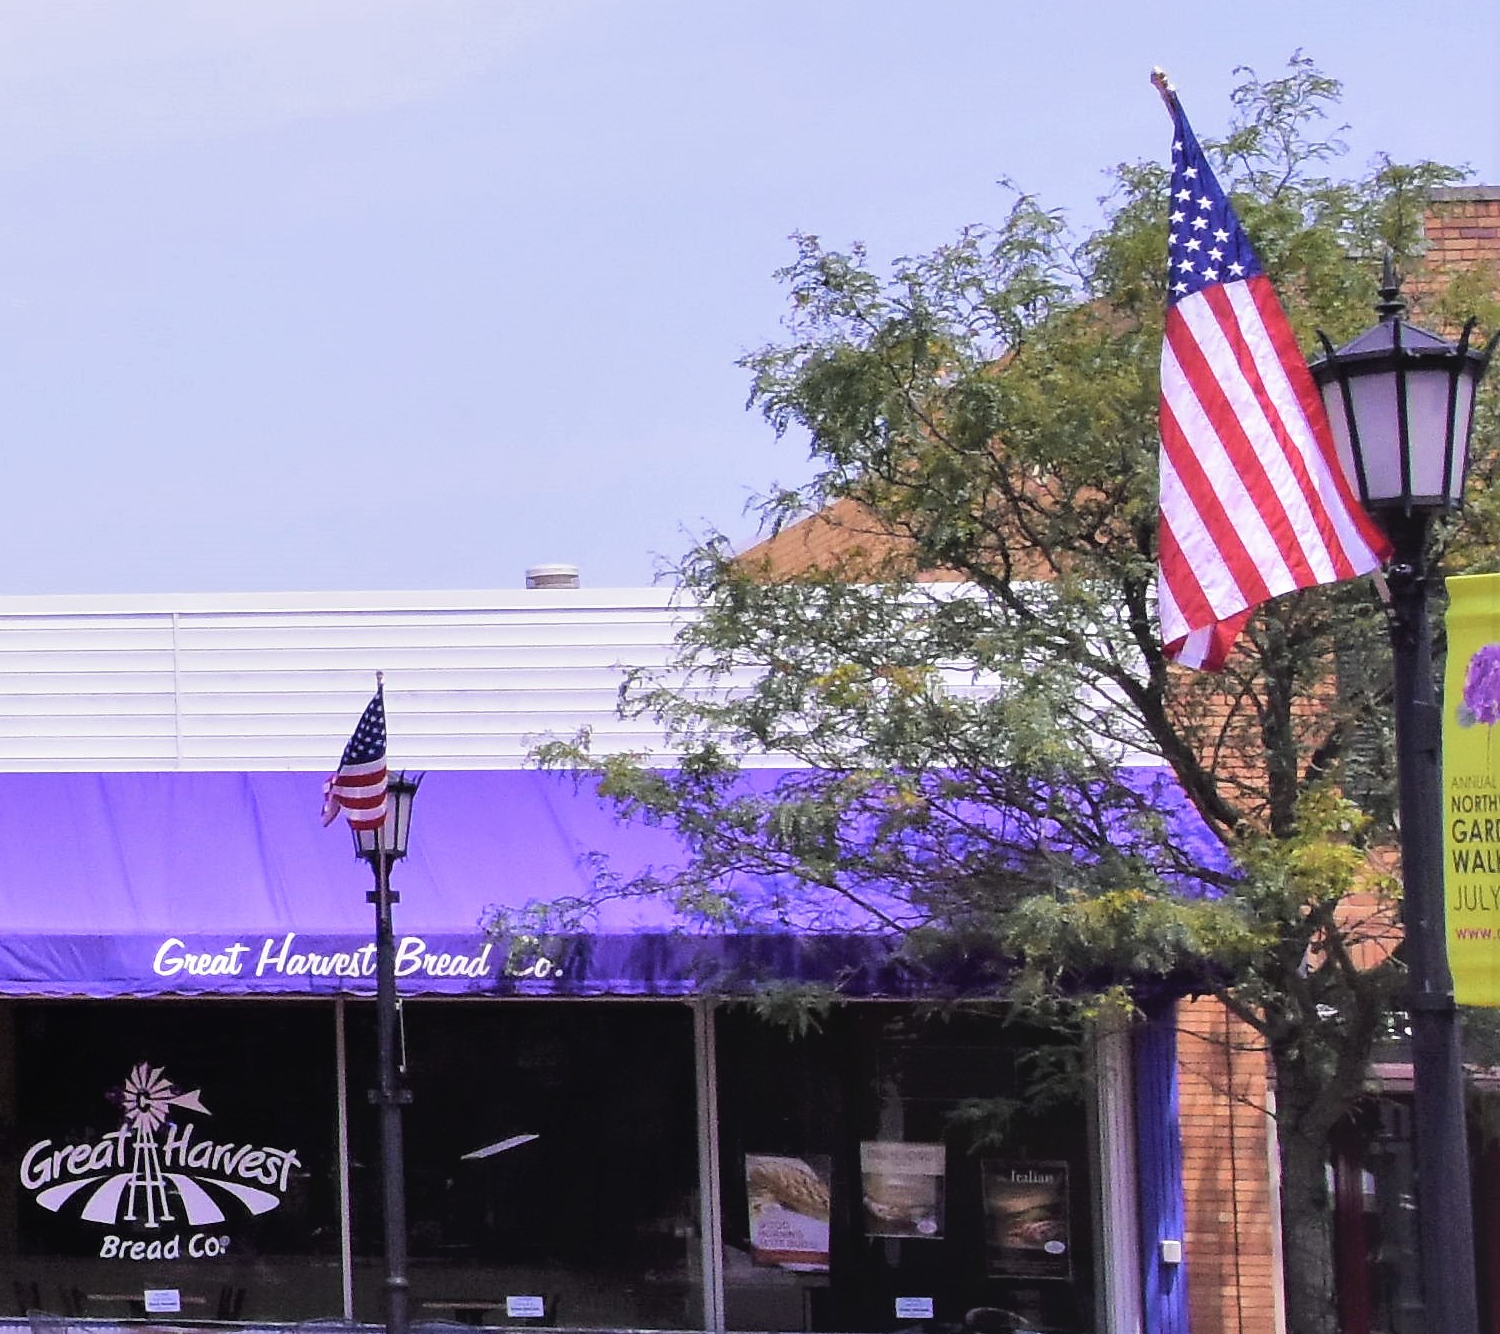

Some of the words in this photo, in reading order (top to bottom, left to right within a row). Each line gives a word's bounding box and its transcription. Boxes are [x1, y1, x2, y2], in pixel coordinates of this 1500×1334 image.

[1451, 775, 1497, 789] ANNUAL
[1451, 795, 1500, 813] NORTH
[153, 937, 250, 977] Great
[255, 932, 378, 977] Harvest
[394, 937, 492, 977] Bread
[20, 1123, 132, 1190] Great
[163, 1123, 302, 1192] Harvest
[1011, 1169, 1053, 1183] Italian
[100, 1235, 180, 1260] Bread
